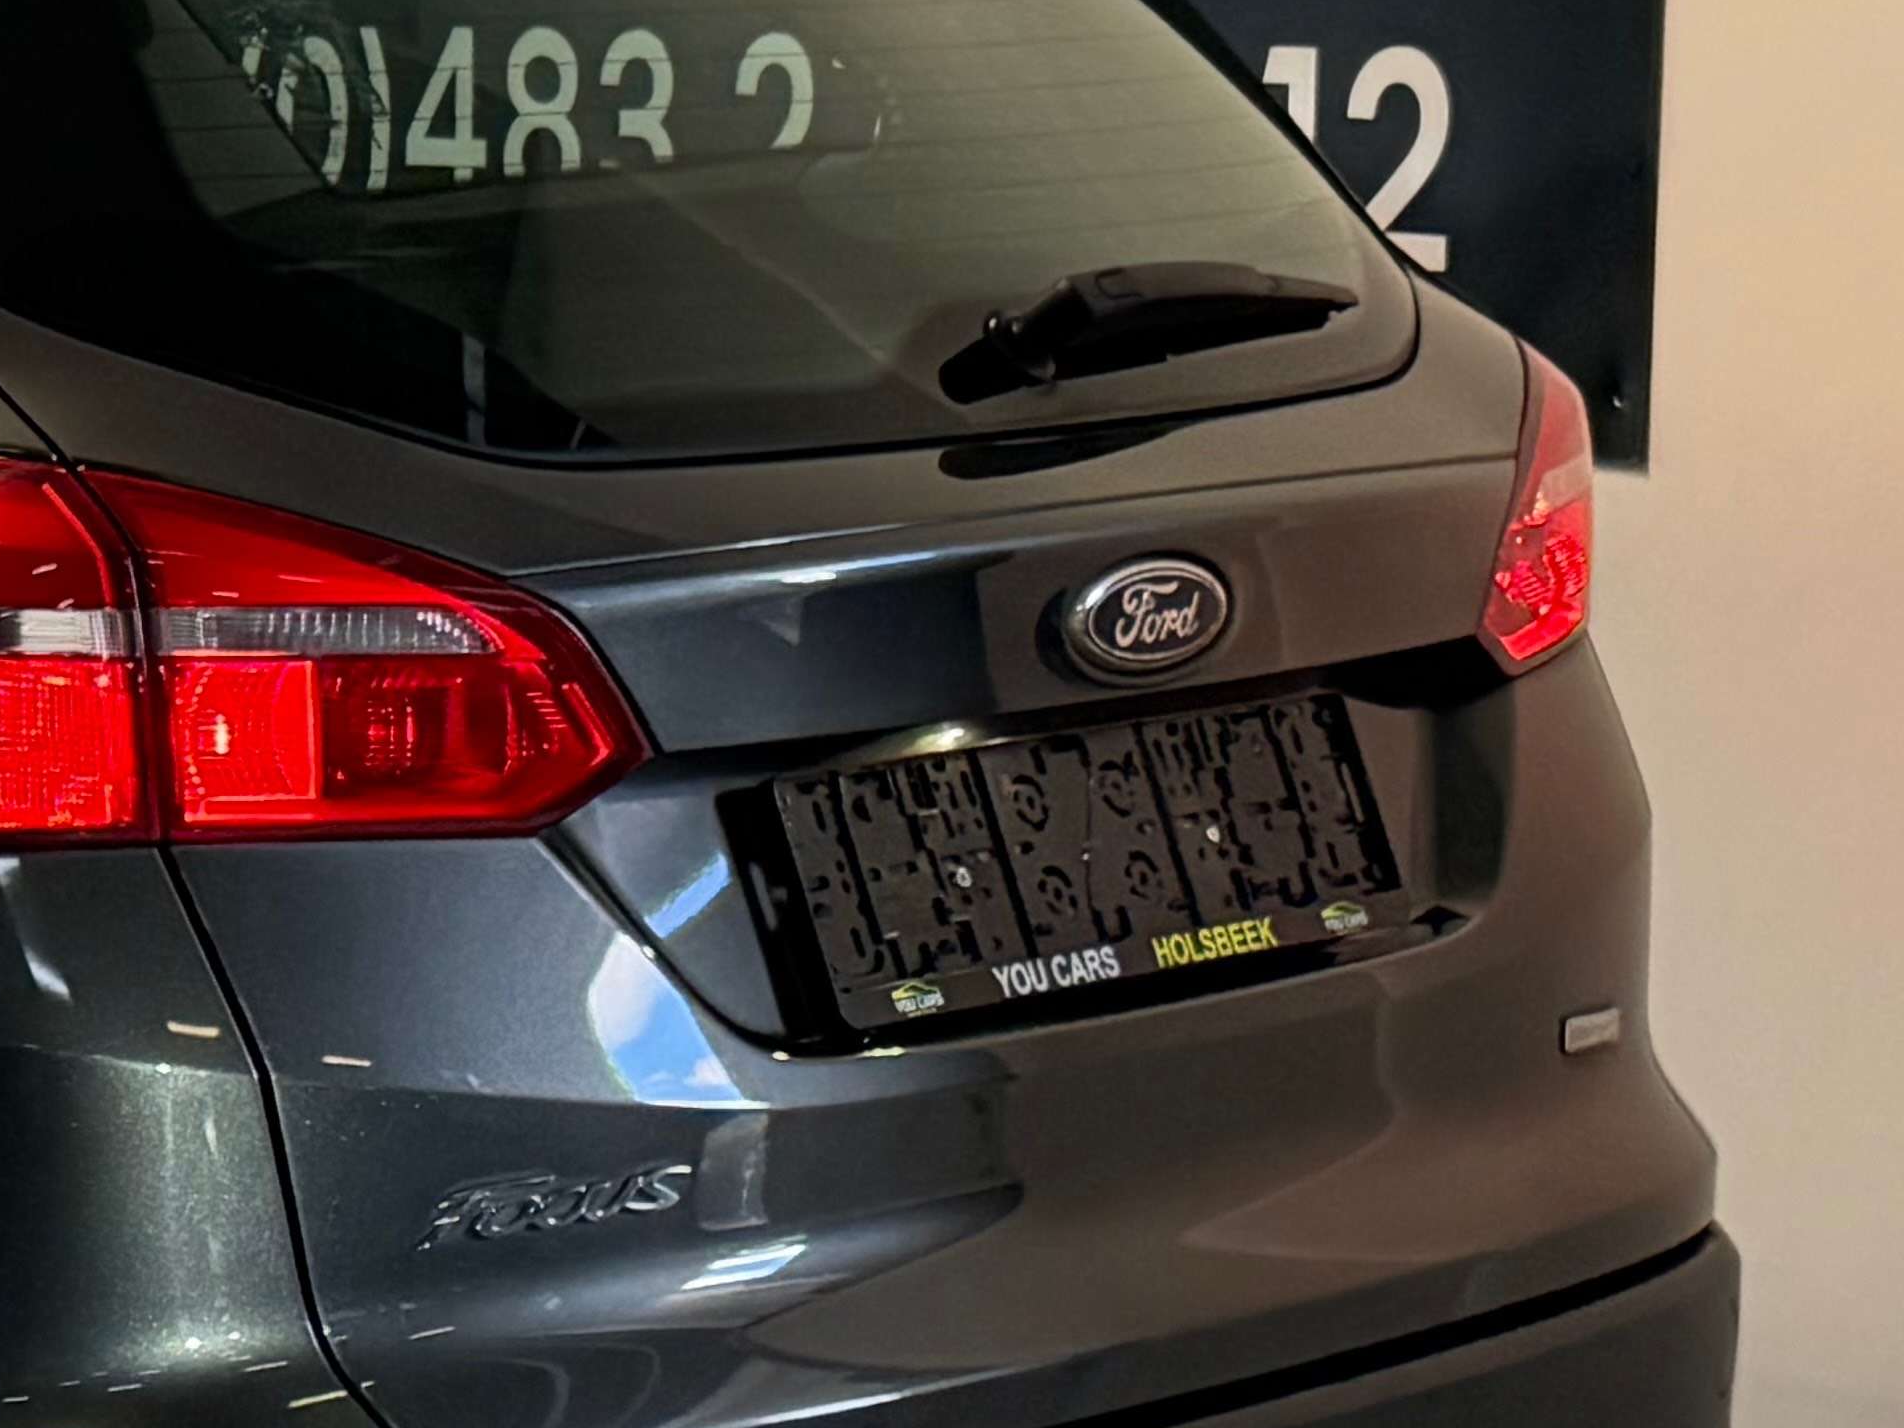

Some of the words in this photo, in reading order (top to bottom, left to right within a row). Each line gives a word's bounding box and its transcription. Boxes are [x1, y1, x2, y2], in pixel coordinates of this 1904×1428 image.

[1114, 581, 1200, 648] Ford
[991, 957, 1049, 999] YOU
[1050, 945, 1122, 988] CARS
[1150, 917, 1279, 969] HOLSBEEK
